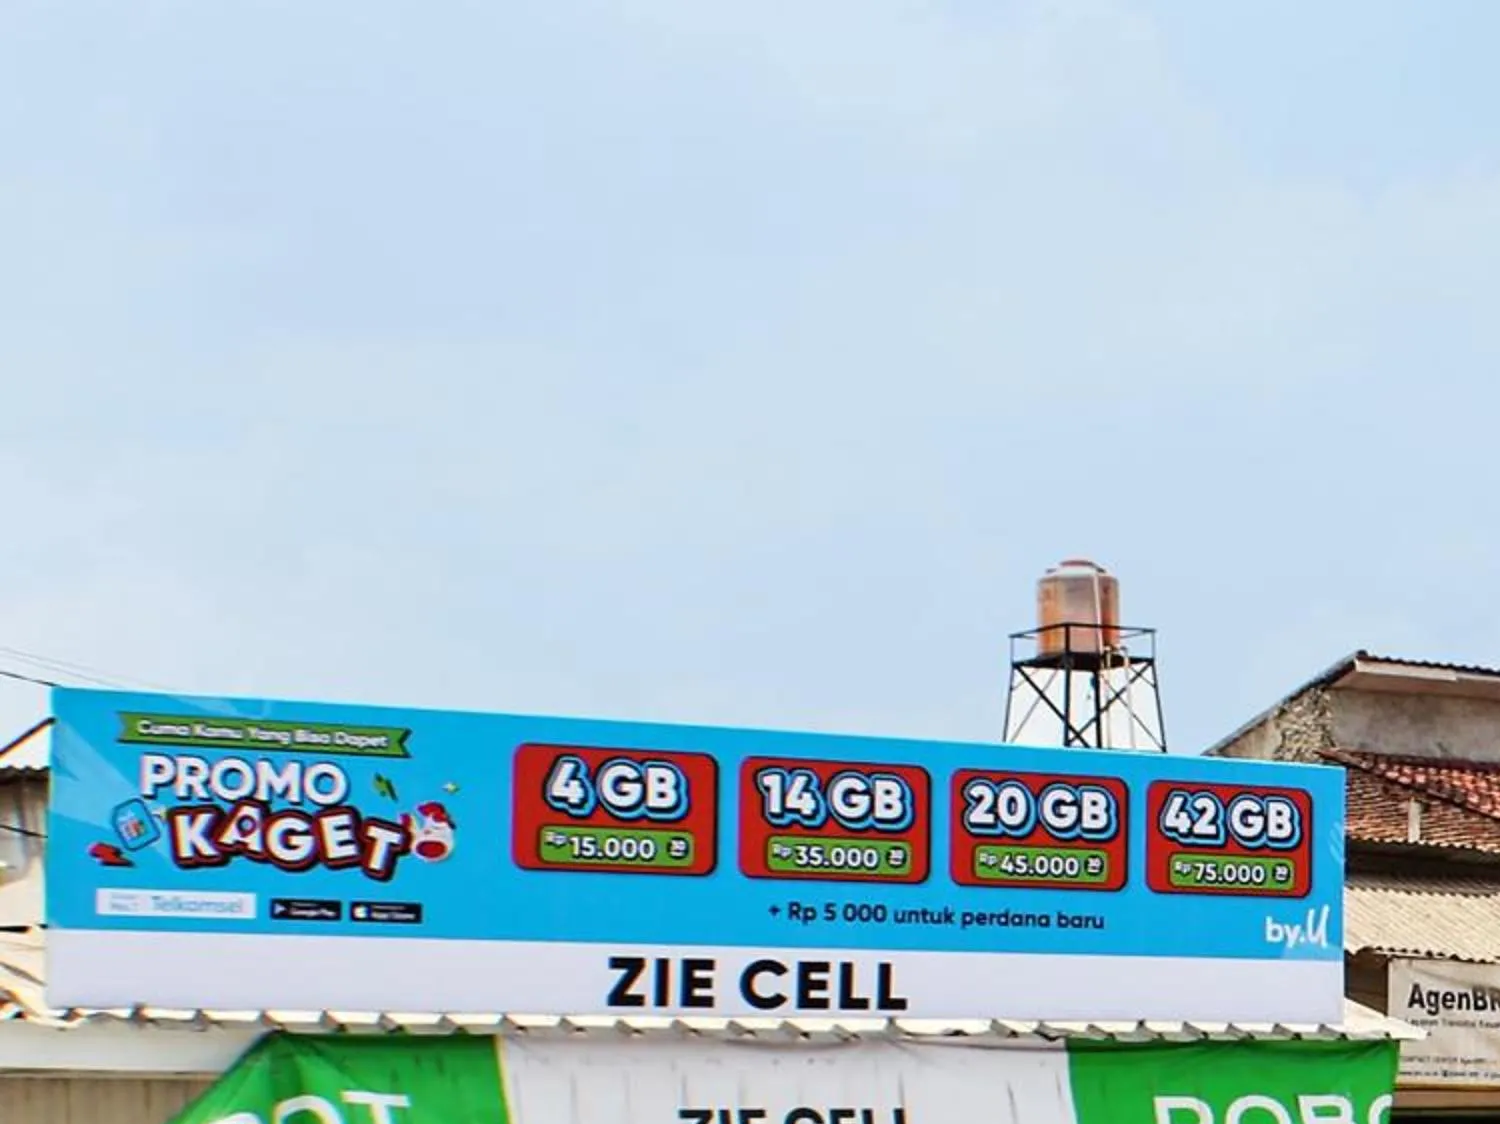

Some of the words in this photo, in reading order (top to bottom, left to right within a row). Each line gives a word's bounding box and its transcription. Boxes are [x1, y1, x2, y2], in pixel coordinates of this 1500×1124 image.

[140, 753, 348, 804] PROMO
[545, 756, 588, 812] 4
[599, 761, 685, 813] GB
[758, 771, 822, 821] 14
[829, 775, 911, 826] GB
[964, 781, 1030, 830] 20
[1039, 789, 1113, 837] GB
[1163, 795, 1222, 840] 42
[1228, 802, 1296, 846] GB
[172, 802, 403, 878] KAGET
[569, 835, 656, 861] 15.000
[794, 845, 879, 869] 35.000
[1000, 853, 1080, 878] 45.000
[1193, 862, 1266, 885] 75.000
[787, 902, 818, 926] Rp
[823, 903, 838, 922] 5
[893, 907, 955, 927] untuk
[960, 907, 1052, 933] perdana
[1056, 910, 1105, 930] baru
[606, 957, 717, 1009] ZIE
[738, 958, 908, 1012] CELL
